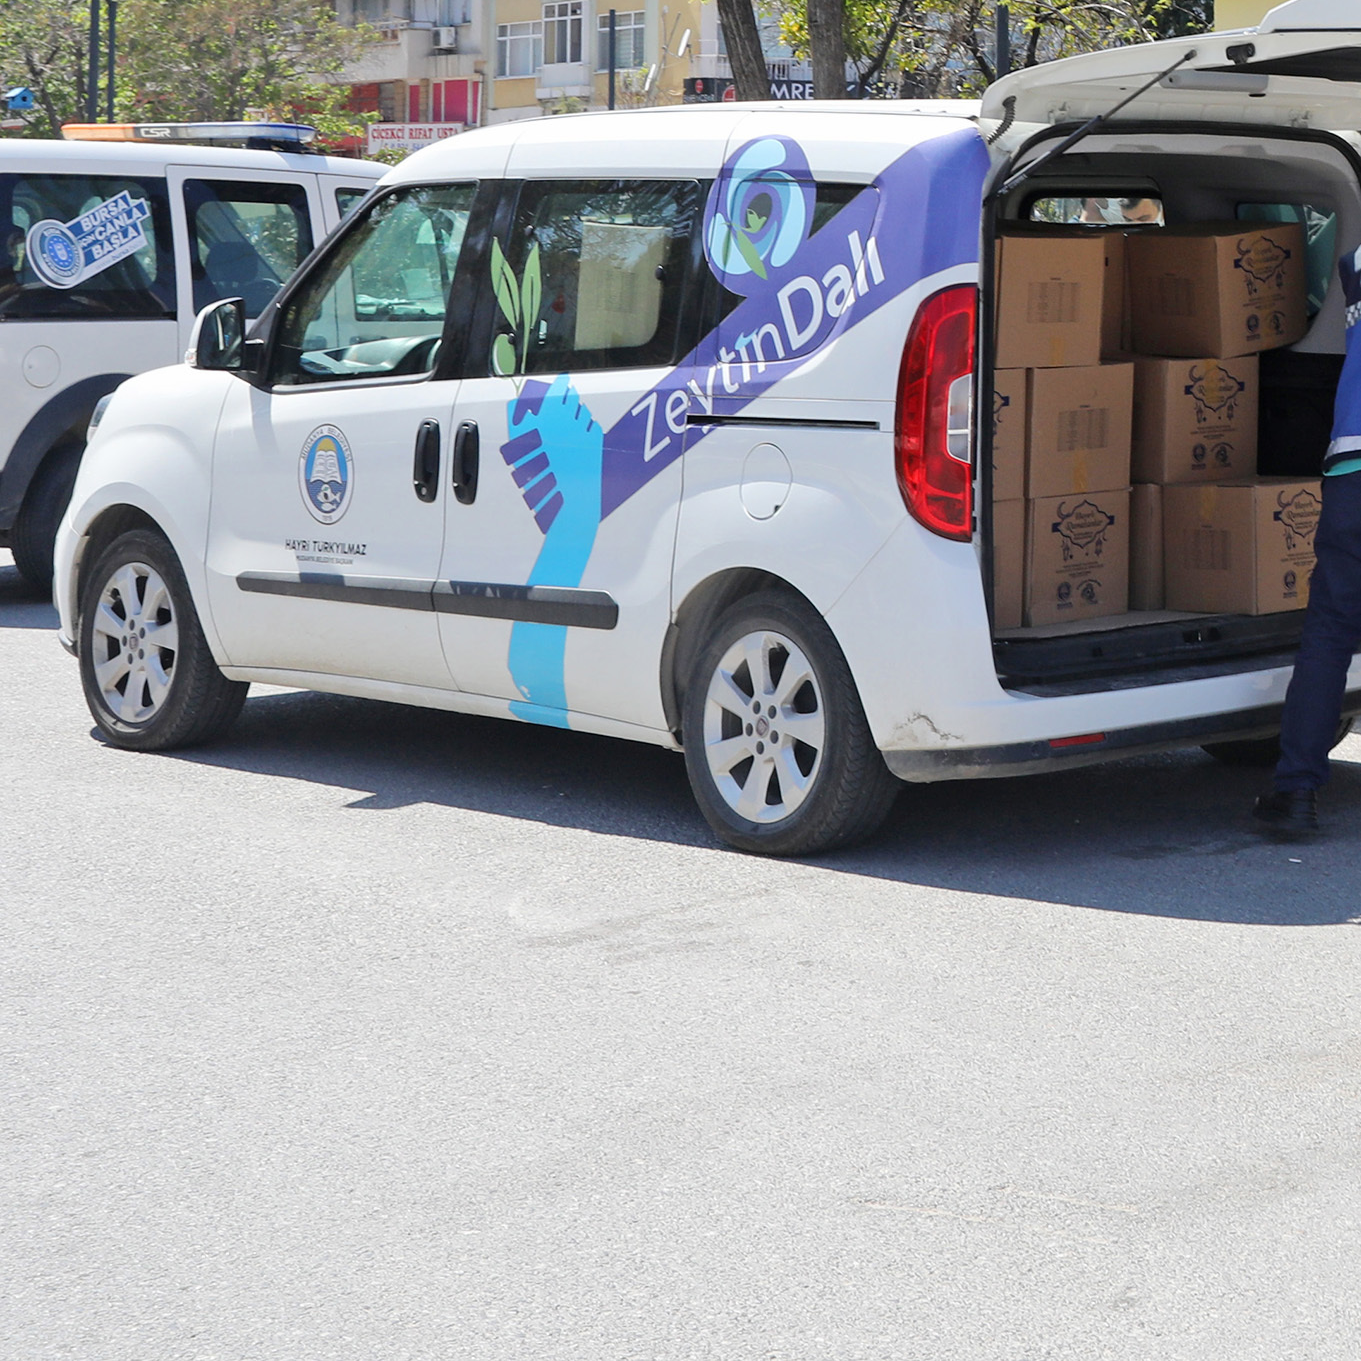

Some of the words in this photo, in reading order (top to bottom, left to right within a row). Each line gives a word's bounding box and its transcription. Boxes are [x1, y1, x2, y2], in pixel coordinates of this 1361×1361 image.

[140, 127, 171, 138] CSR
[409, 127, 433, 140] RIFAT
[80, 198, 129, 232] BURSA
[94, 207, 143, 238] CANLA
[91, 225, 139, 260] BAŞLA
[285, 539, 309, 552] HAYRİ
[312, 540, 367, 556] TÜRKYILMAZ
